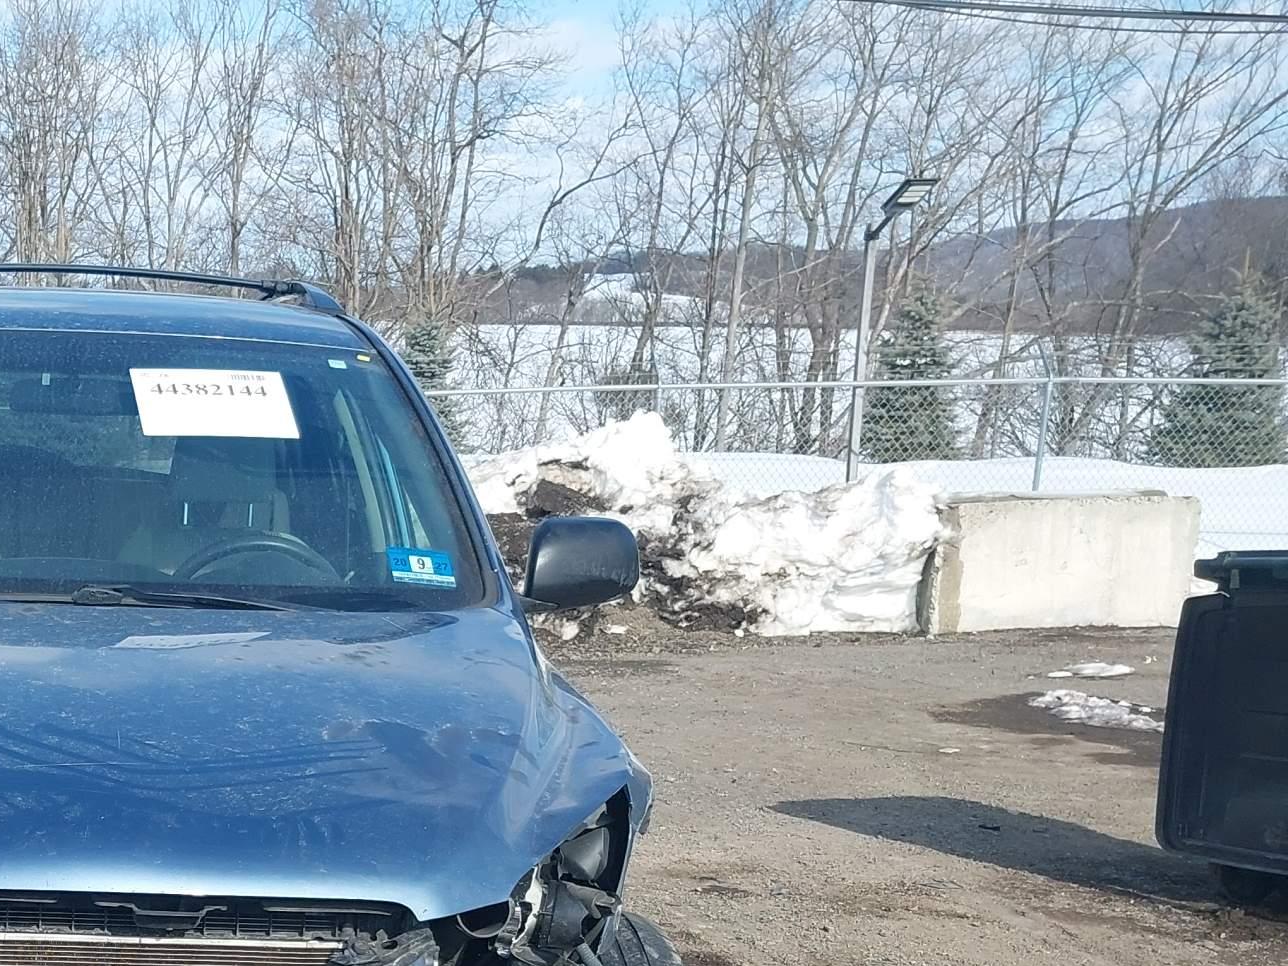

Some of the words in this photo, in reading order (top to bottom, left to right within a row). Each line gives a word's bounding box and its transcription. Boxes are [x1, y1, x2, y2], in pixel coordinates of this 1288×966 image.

[150, 383, 268, 397] 44382144
[392, 557, 407, 567] 20
[416, 557, 425, 570] 9
